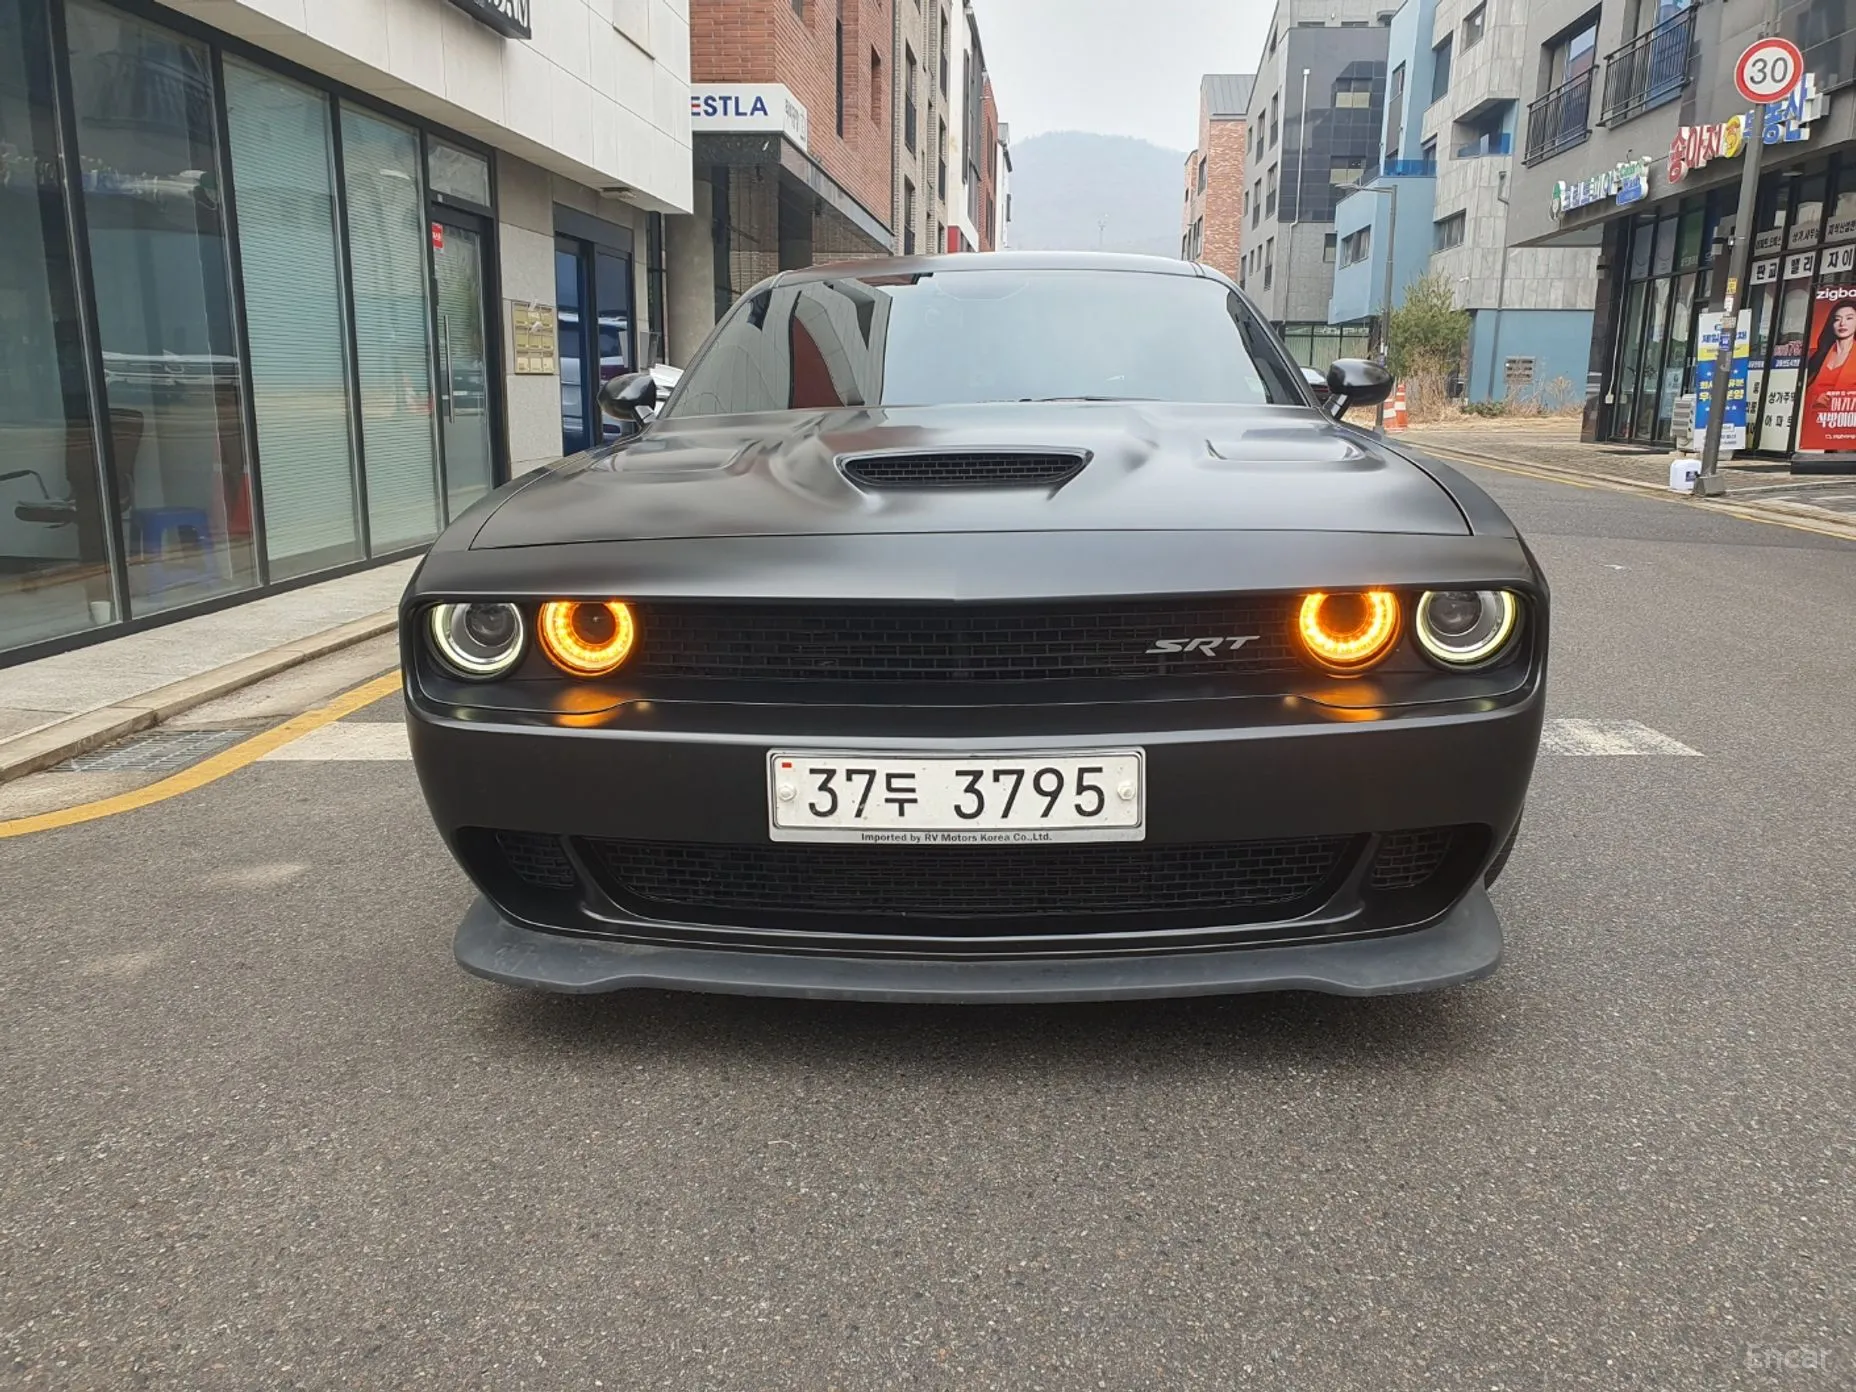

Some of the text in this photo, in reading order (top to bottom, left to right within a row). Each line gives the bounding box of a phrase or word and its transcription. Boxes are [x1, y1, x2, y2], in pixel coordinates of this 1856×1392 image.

[1750, 57, 1788, 85] 30
[691, 95, 768, 117] ESTLA
[1668, 126, 1724, 184] 송아지
[1827, 249, 1853, 268] 자이
[1145, 635, 1261, 657] SRT
[808, 766, 1105, 819] 37두 3795
[861, 832, 907, 843] Imported
[910, 833, 921, 843] by
[924, 833, 939, 842] RV
[941, 833, 978, 842] Motors
[980, 833, 1011, 842] Korea
